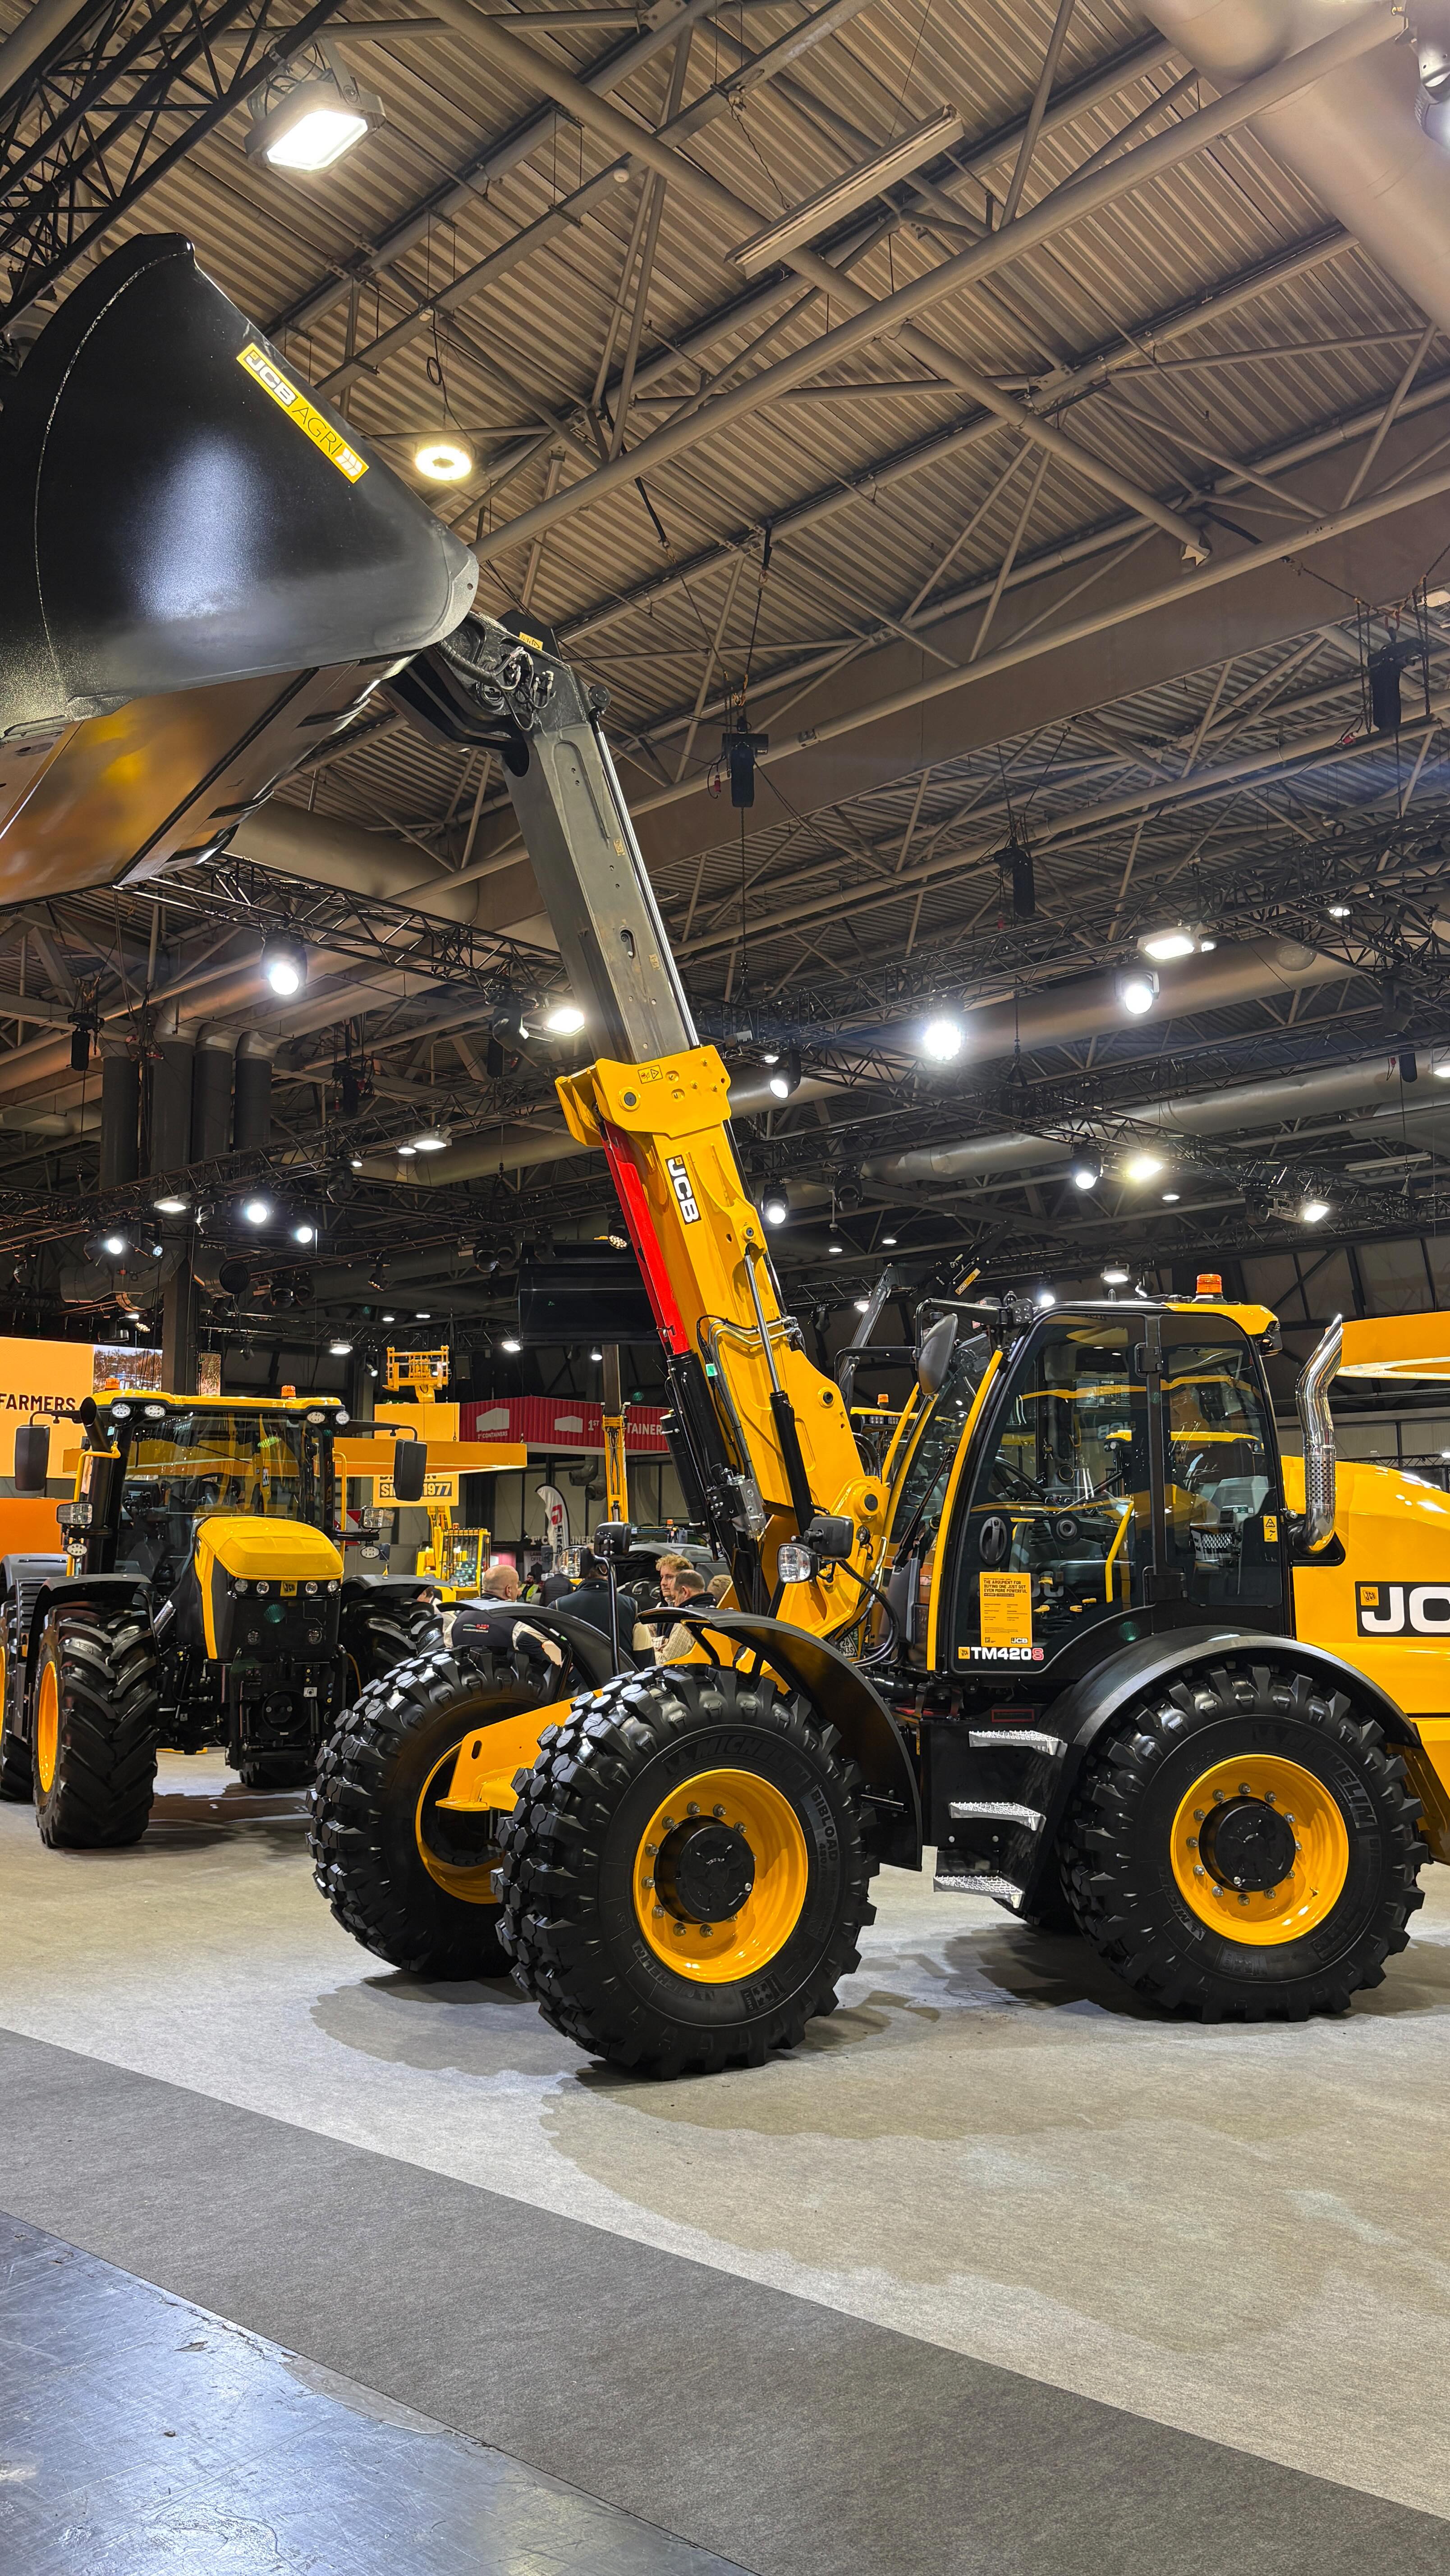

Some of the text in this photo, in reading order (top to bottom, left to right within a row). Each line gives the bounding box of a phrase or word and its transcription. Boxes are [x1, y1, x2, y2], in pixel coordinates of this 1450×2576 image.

[246, 354, 343, 455] JCB AGRI
[668, 1159, 690, 1223] JCB
[0, 1393, 76, 1411] FARMERS
[423, 1483, 450, 1496] 1977
[971, 1647, 1044, 1661] TM420S
[811, 1789, 838, 1861] BIBLOAD
